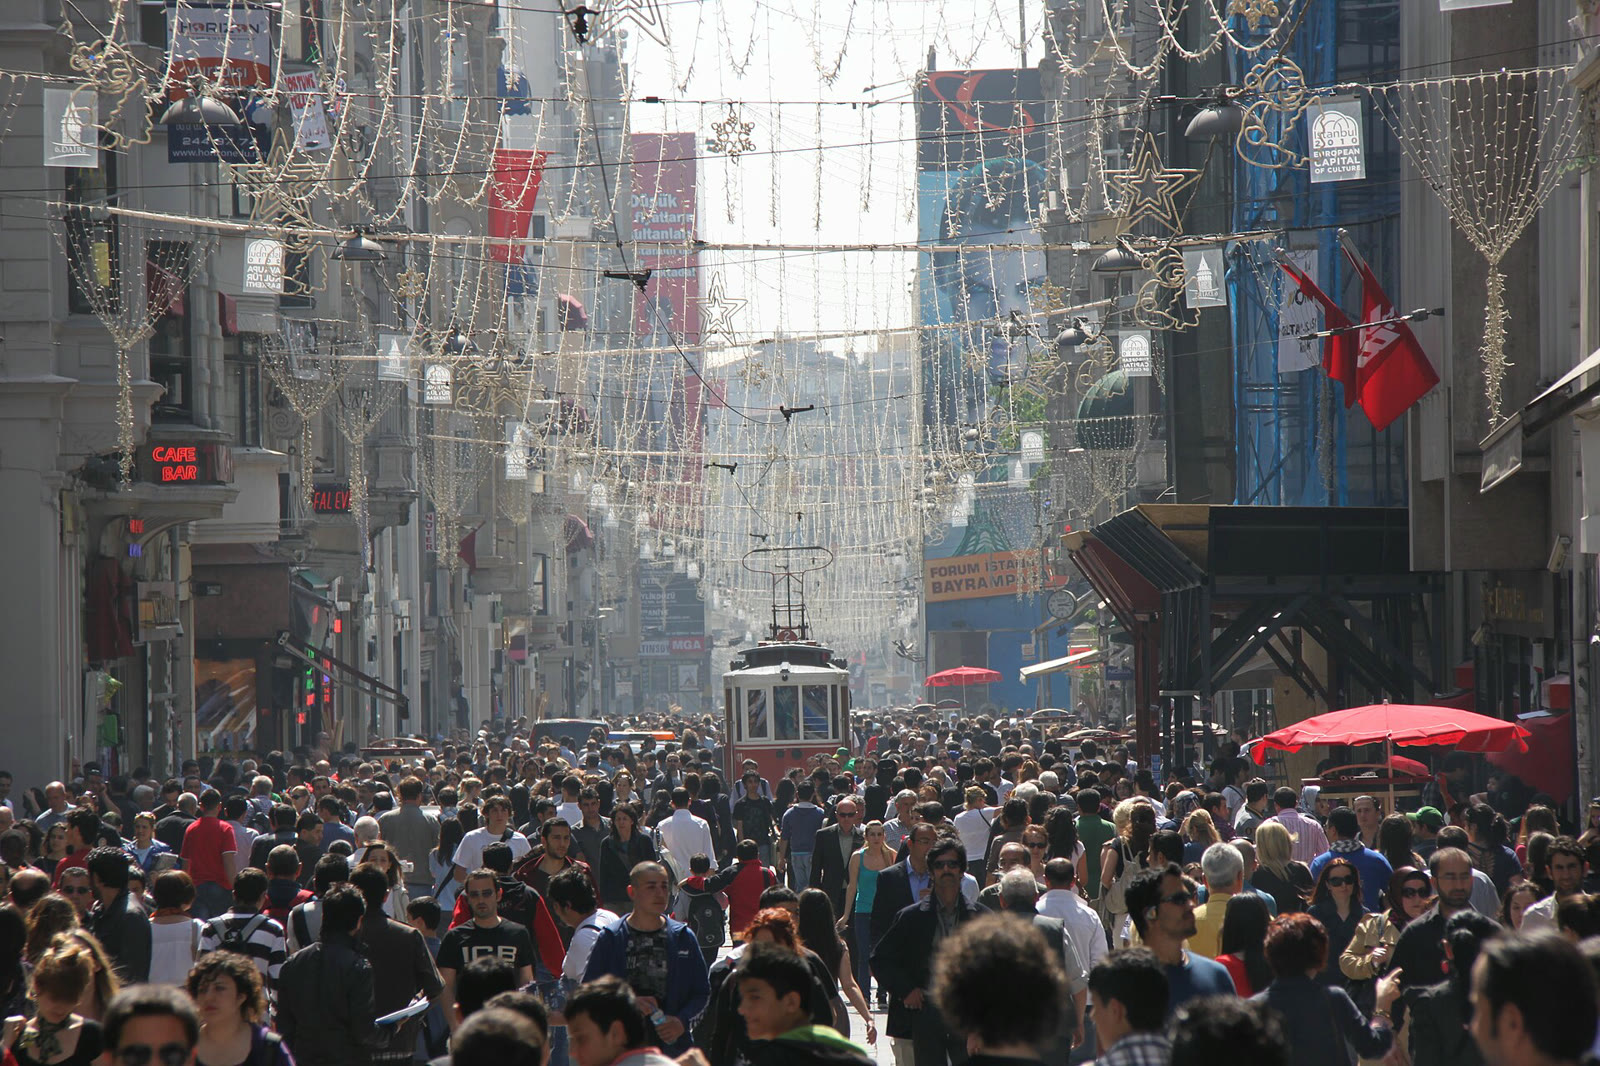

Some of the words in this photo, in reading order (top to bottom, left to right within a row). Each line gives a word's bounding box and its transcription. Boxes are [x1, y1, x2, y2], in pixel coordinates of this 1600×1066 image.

[1327, 165, 1361, 174] CULTURE
[152, 446, 197, 462] CAFE
[162, 465, 197, 482] BAR
[930, 562, 980, 578] FORUM
[784, 631, 791, 641] 2
[671, 639, 702, 650] MGA
